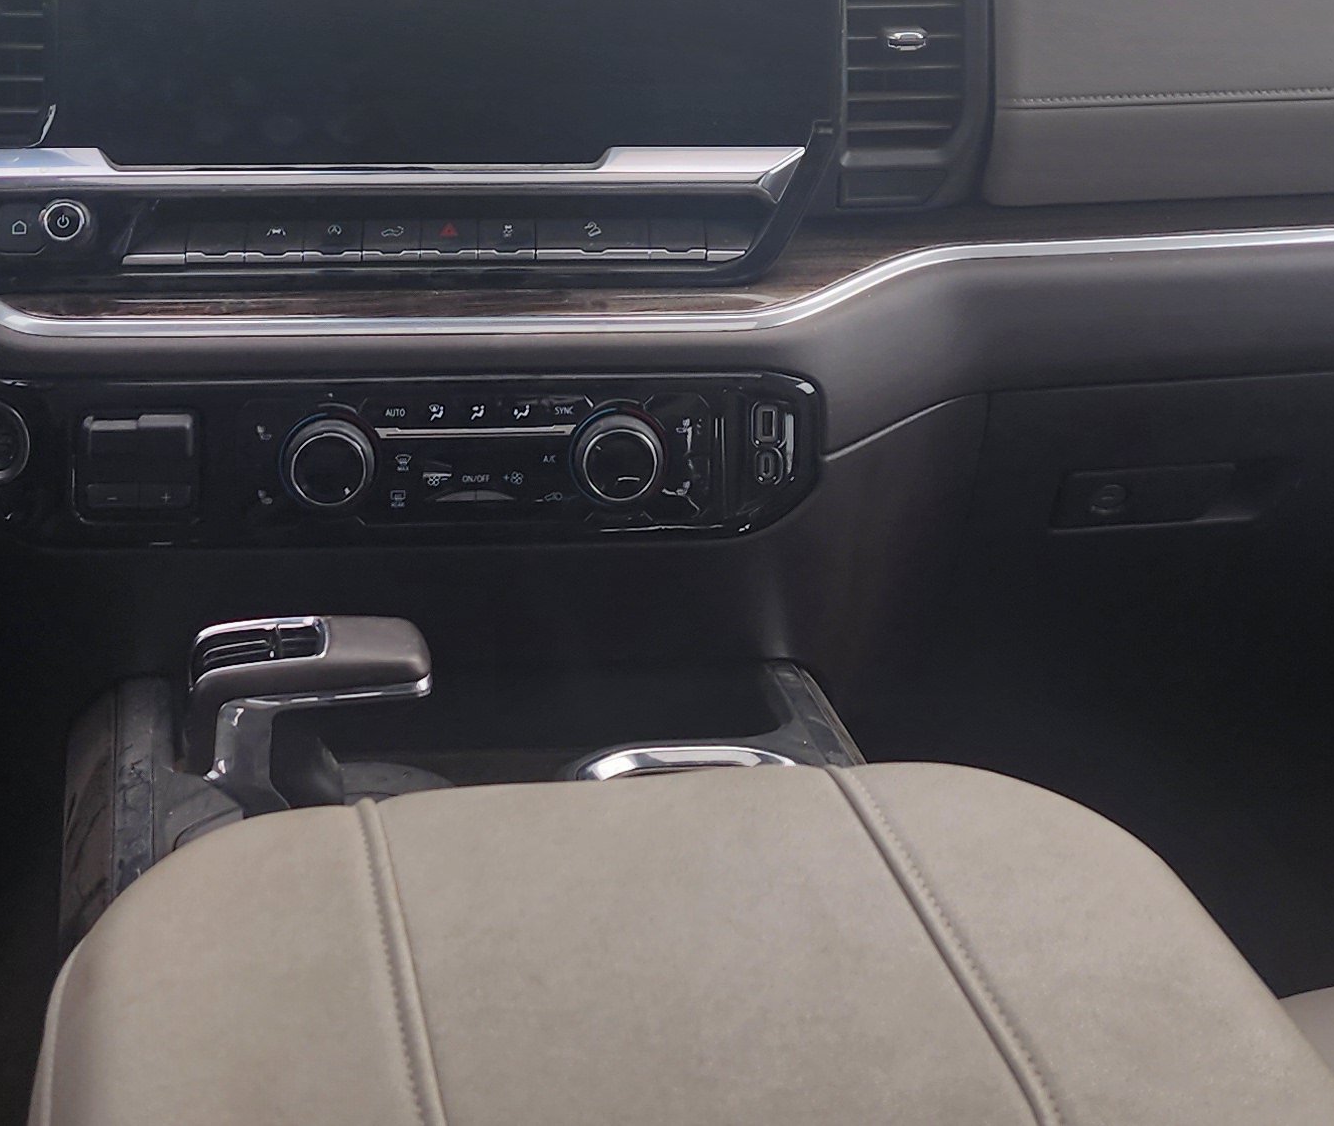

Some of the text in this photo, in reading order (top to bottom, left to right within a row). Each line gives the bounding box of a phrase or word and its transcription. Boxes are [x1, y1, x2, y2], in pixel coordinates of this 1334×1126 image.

[385, 408, 406, 417] AUTO
[554, 406, 574, 416] SYNC
[542, 454, 556, 464] A/C
[462, 475, 490, 484] ON/OFF
